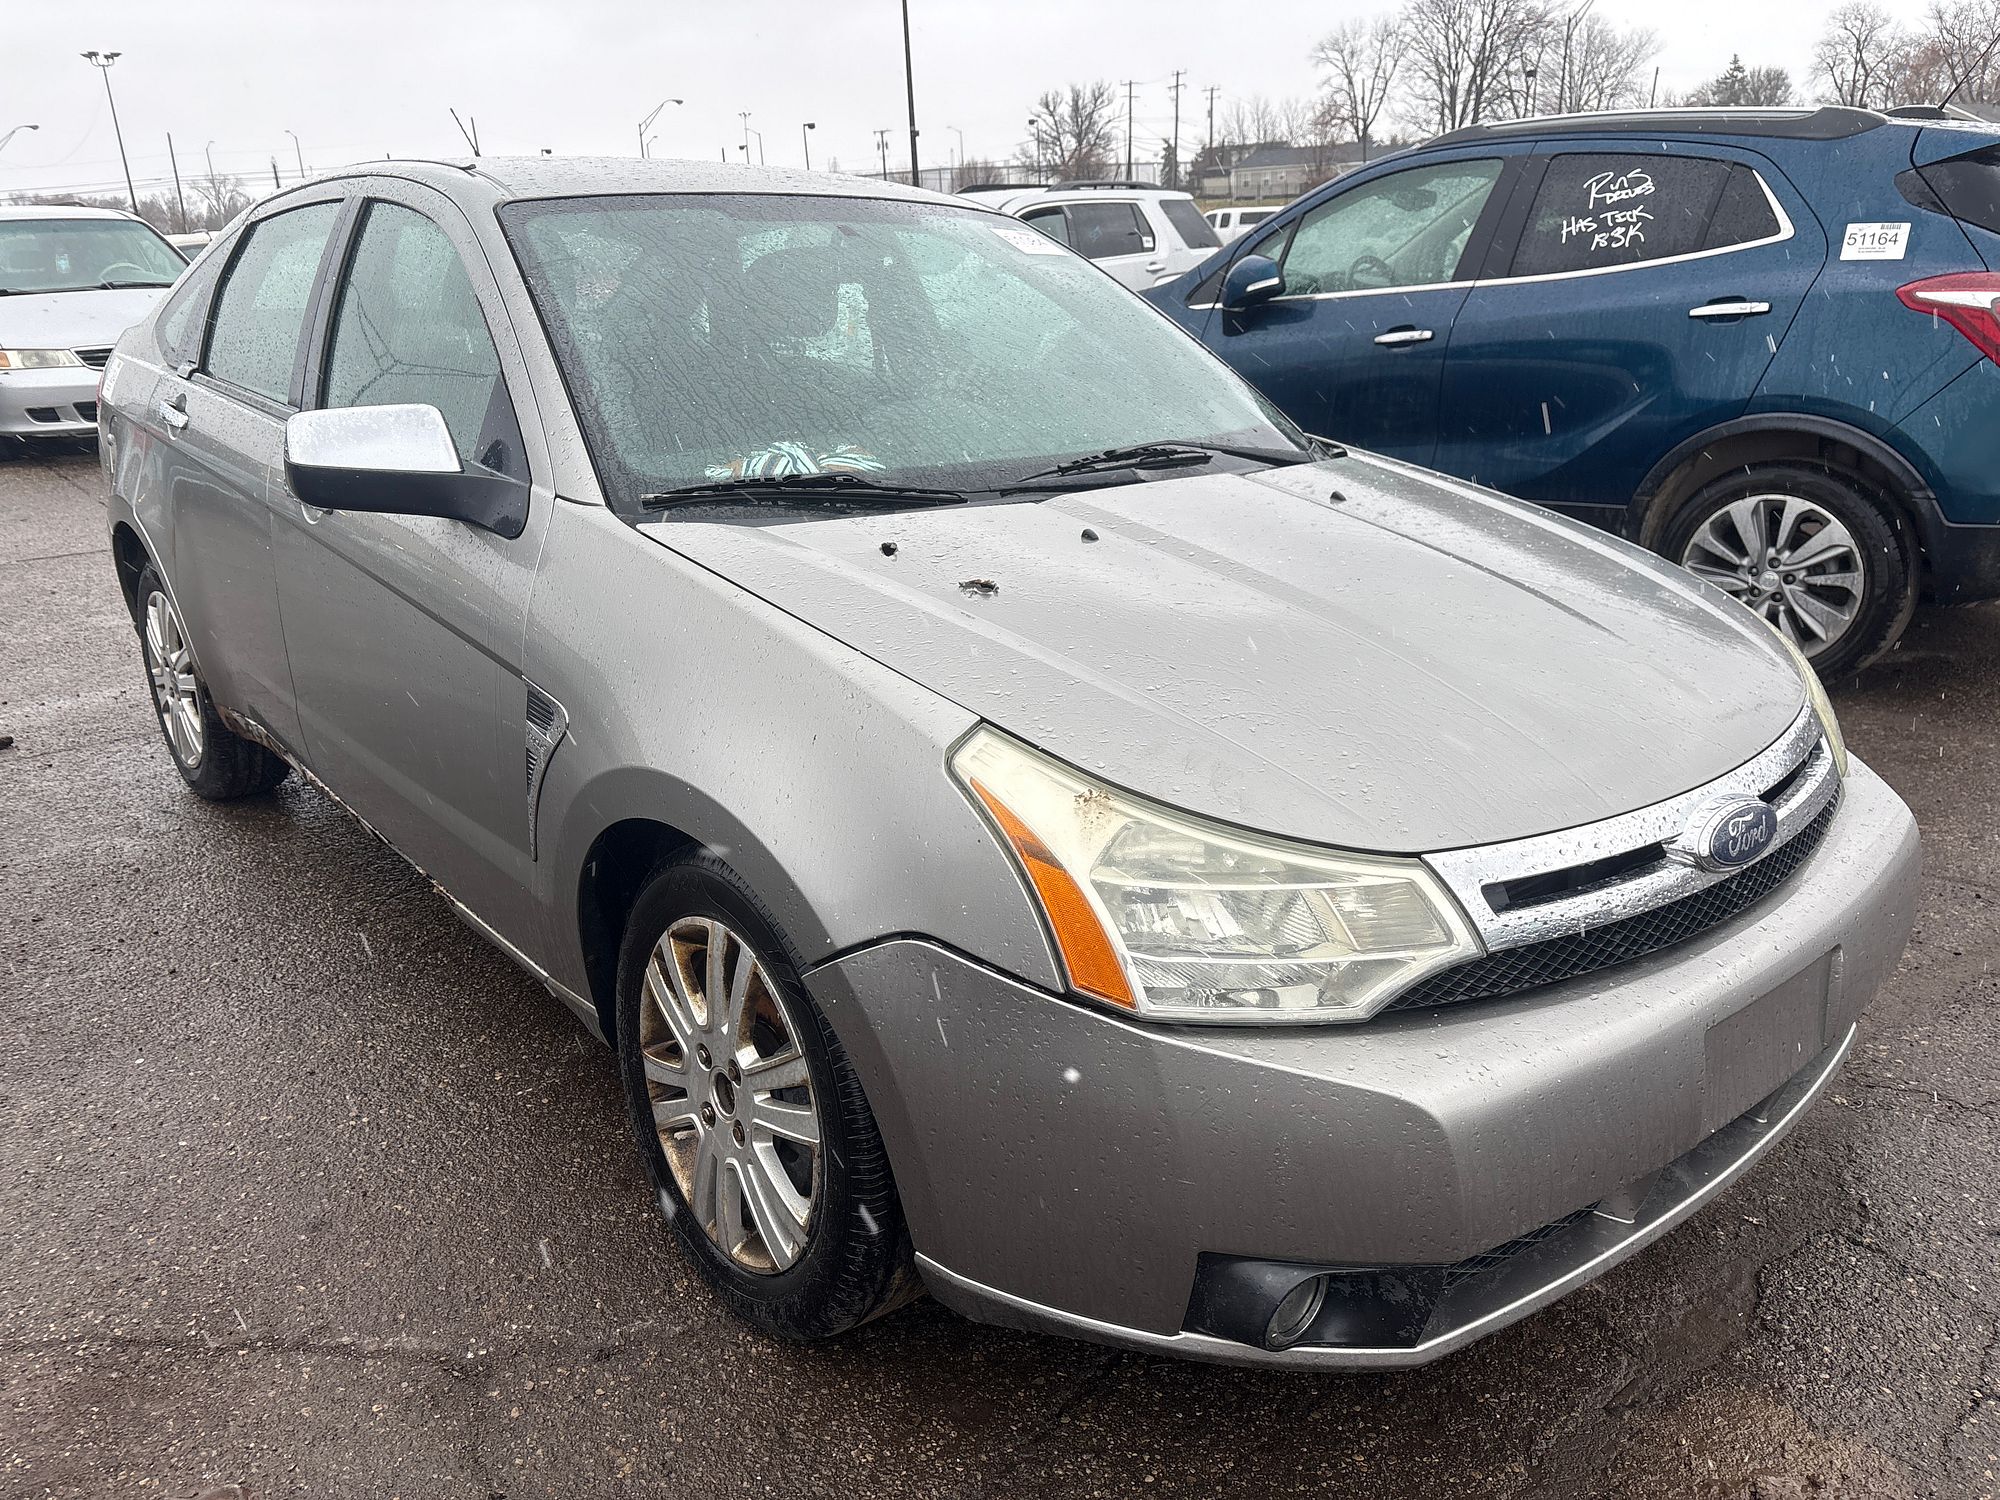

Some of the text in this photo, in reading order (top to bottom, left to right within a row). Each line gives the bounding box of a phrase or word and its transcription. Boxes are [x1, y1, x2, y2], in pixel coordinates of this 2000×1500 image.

[1561, 215, 1598, 244] HAS
[1590, 222, 1645, 251] 183K
[1847, 232, 1899, 246] 51164
[1728, 811, 1769, 858] Ford
